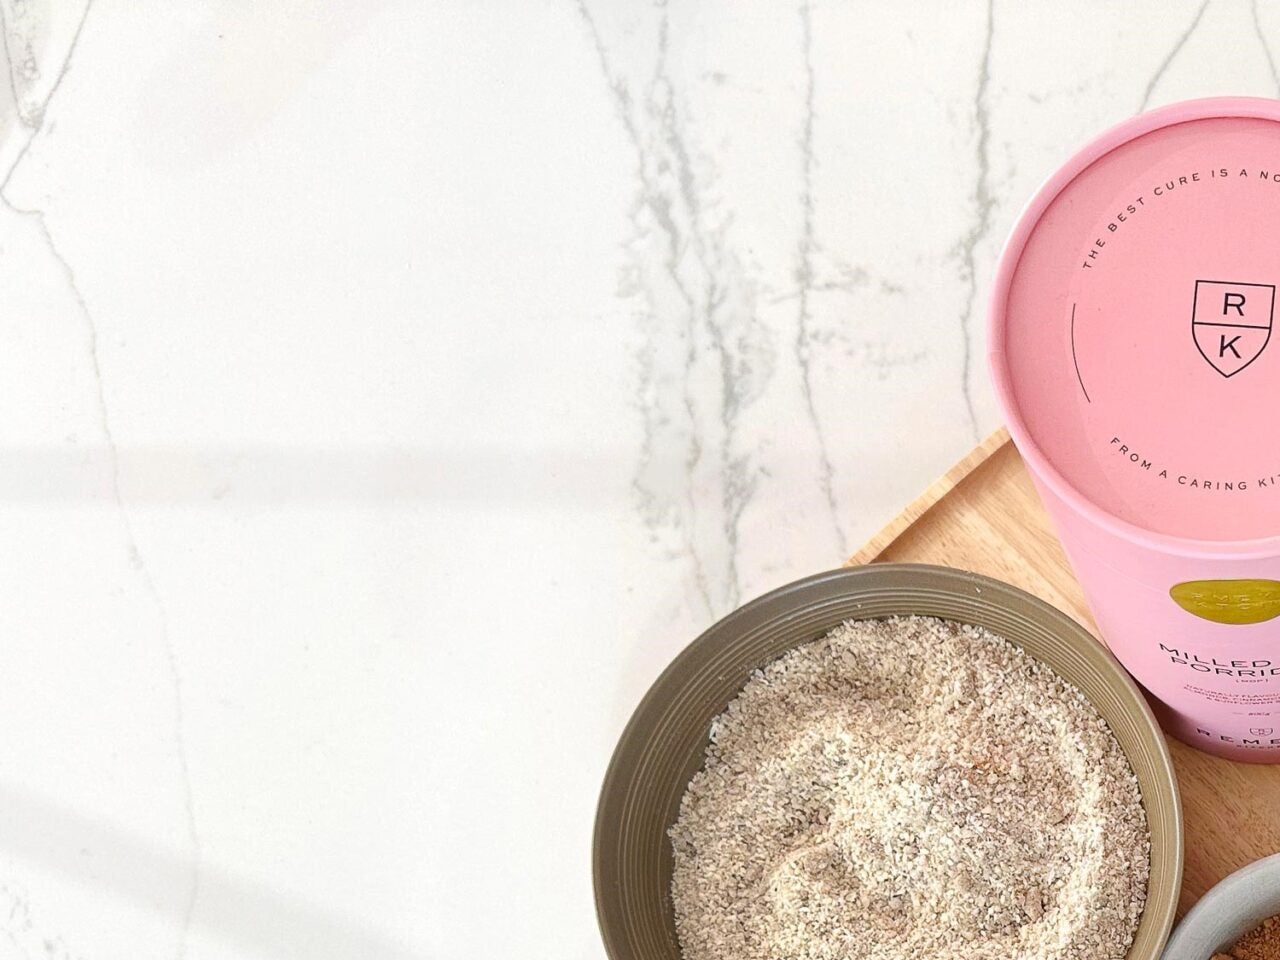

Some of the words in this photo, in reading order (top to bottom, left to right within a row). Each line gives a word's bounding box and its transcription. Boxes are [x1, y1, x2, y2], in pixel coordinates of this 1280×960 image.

[1083, 239, 1105, 268] THE
[1108, 197, 1144, 232] BEST
[1154, 173, 1200, 195] CURE
[1212, 170, 1228, 178] IS
[1240, 169, 1248, 177] A
[1223, 292, 1246, 316] R
[1218, 334, 1243, 359] K
[1110, 437, 1152, 470] FROM
[1159, 470, 1167, 478] A
[1178, 476, 1247, 490] CARING
[1158, 643, 1271, 668] MILLED
